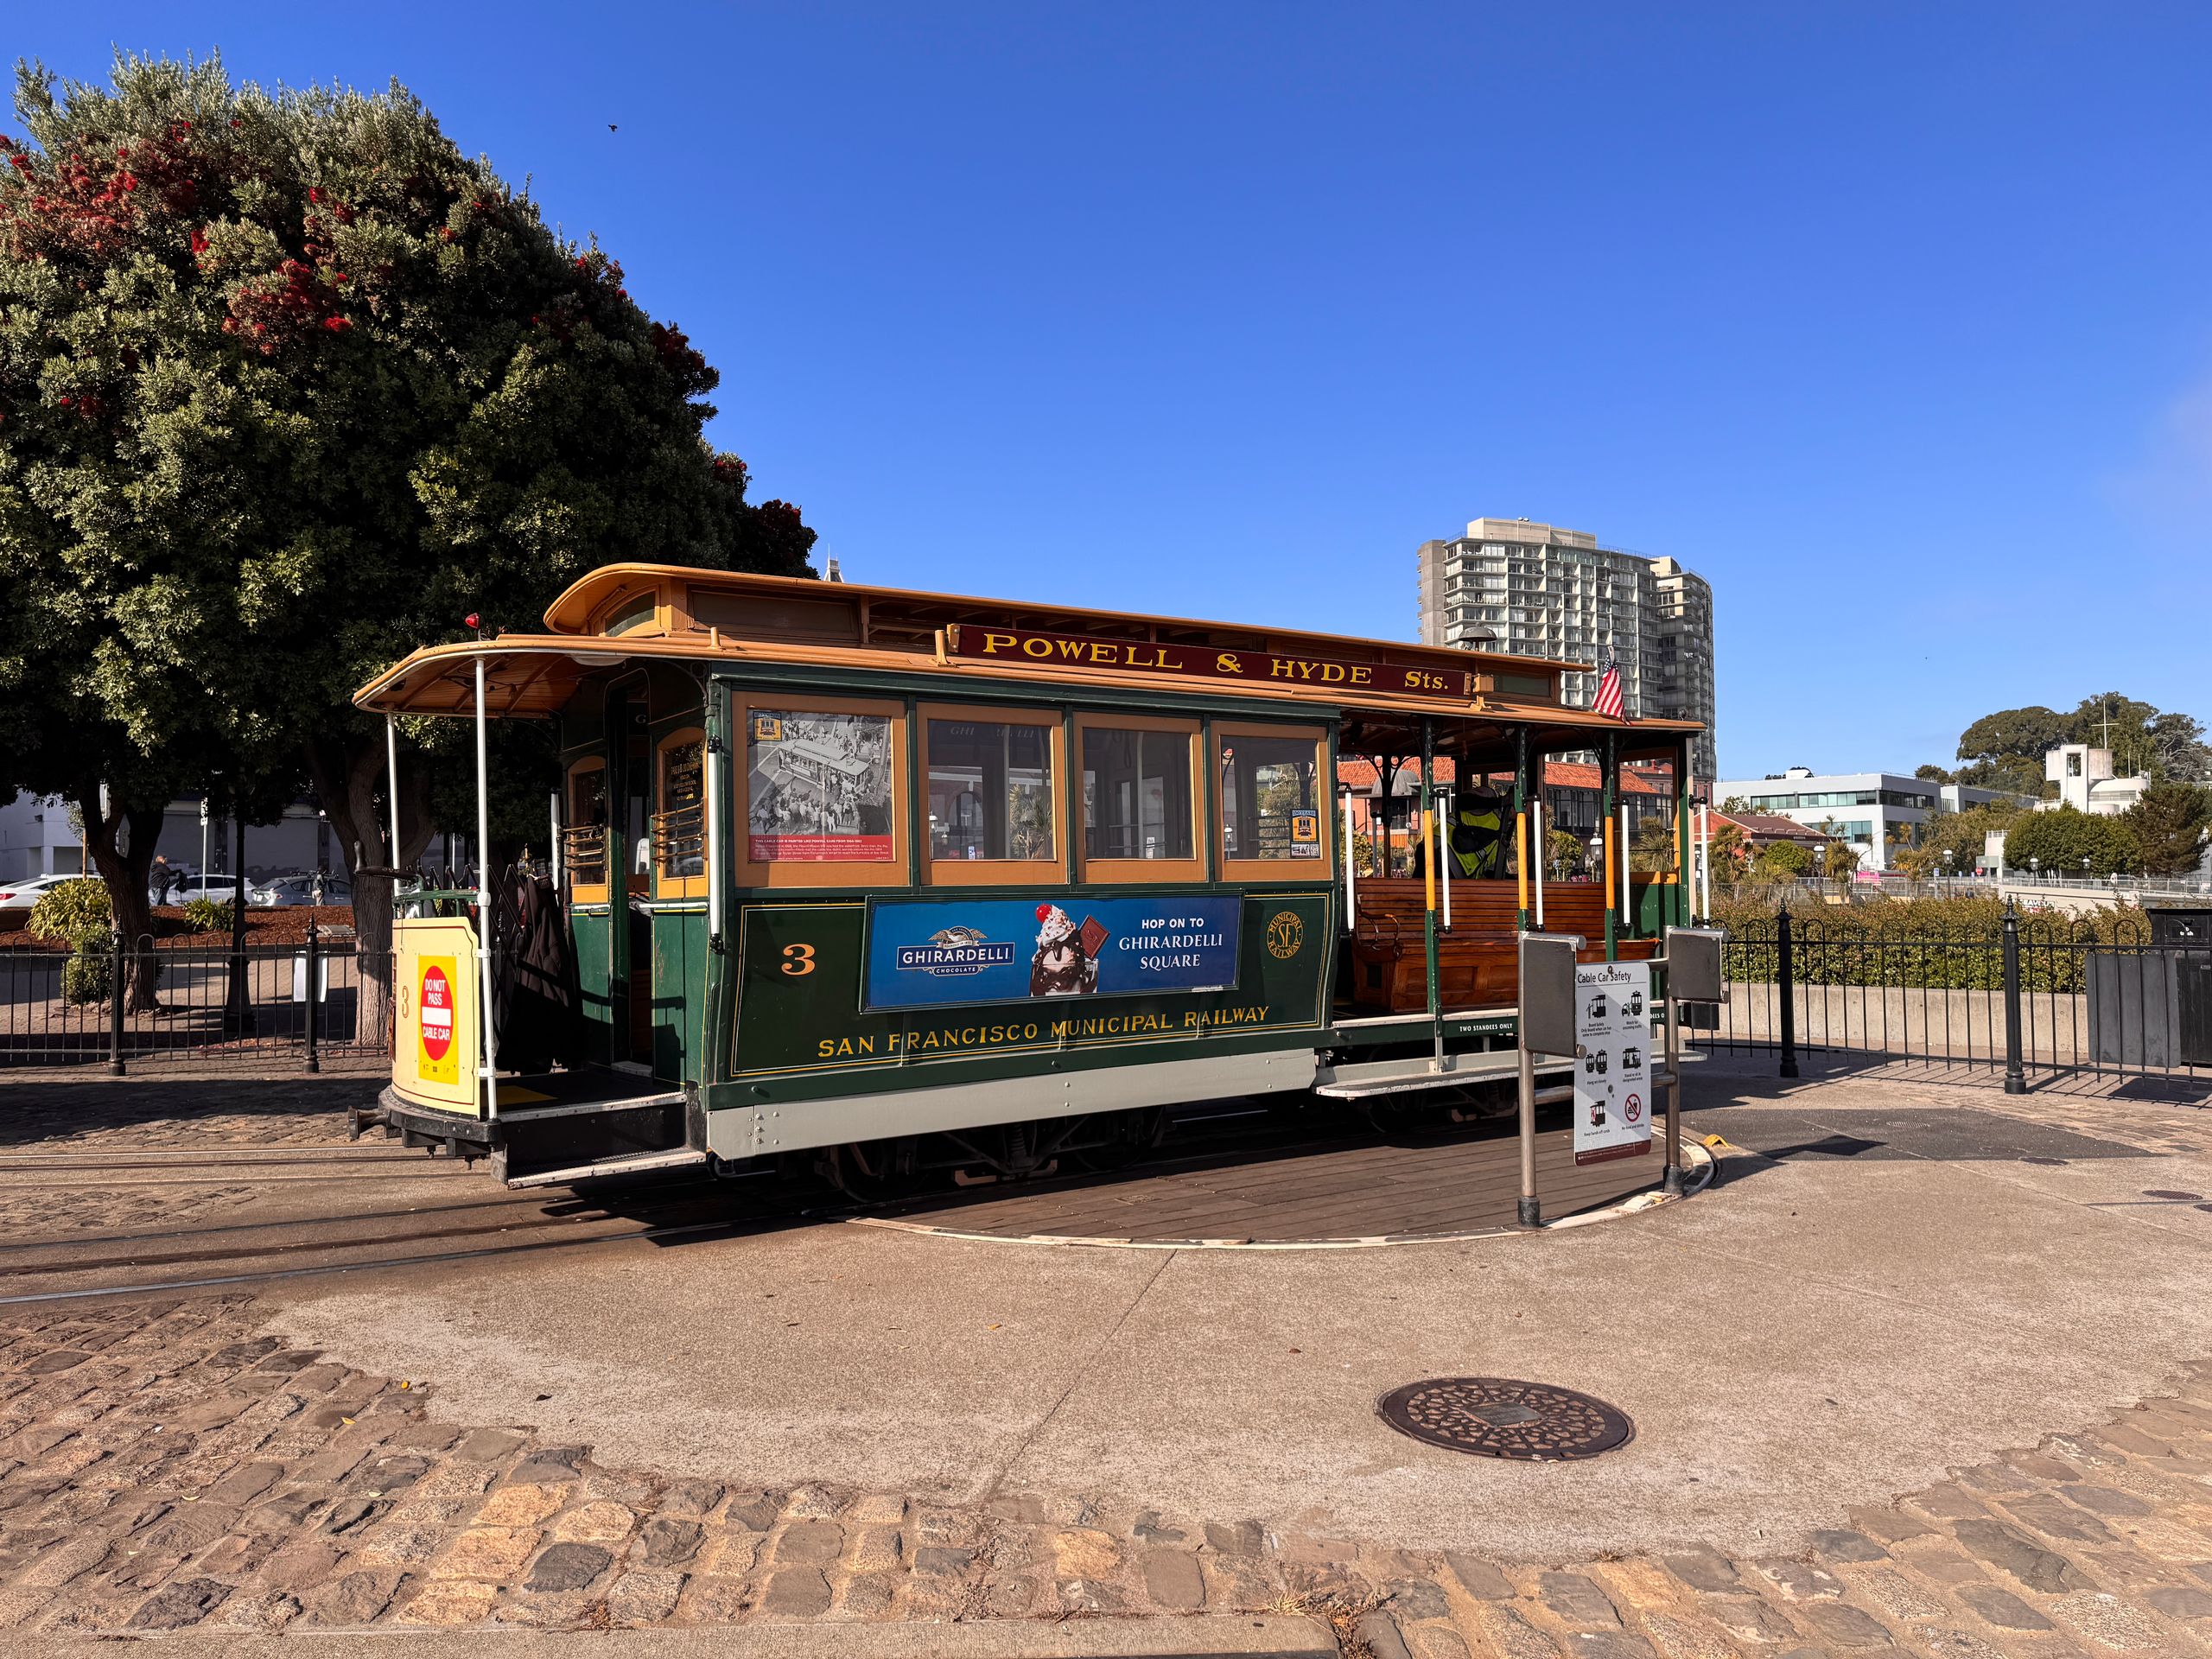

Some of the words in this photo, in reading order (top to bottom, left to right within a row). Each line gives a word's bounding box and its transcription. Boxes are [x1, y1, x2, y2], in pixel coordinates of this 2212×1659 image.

[982, 633, 1183, 669] POWELL
[1216, 653, 1243, 673] &
[1270, 658, 1372, 684] HYDE
[1404, 671, 1449, 690] Sts.
[1142, 919, 1165, 929] HOP
[1169, 918, 1185, 928] ON
[1190, 918, 1204, 927] TO
[1269, 913, 1302, 932] MUNICIPAL
[1119, 934, 1222, 950] GHIRARDELLI
[1268, 939, 1300, 957] RAILWAY
[781, 943, 816, 976] 3
[903, 947, 1009, 964] GHIRARDELLI
[1140, 954, 1201, 971] SQUARE
[425, 978, 433, 991] DO
[433, 979, 446, 992] NOT
[1578, 973, 1596, 983] Cable
[1598, 973, 1609, 982] Car
[1611, 971, 1631, 982] Safety
[402, 985, 409, 1018] 3
[428, 992, 442, 1006] PASS
[423, 1026, 438, 1039] CABLE
[438, 1028, 450, 1041] CAR
[818, 1035, 874, 1058] SAN
[887, 1023, 1038, 1052] FRANCISCO
[1051, 1013, 1173, 1038] MUNICIPAL
[1184, 1006, 1270, 1027] RAILWAY
